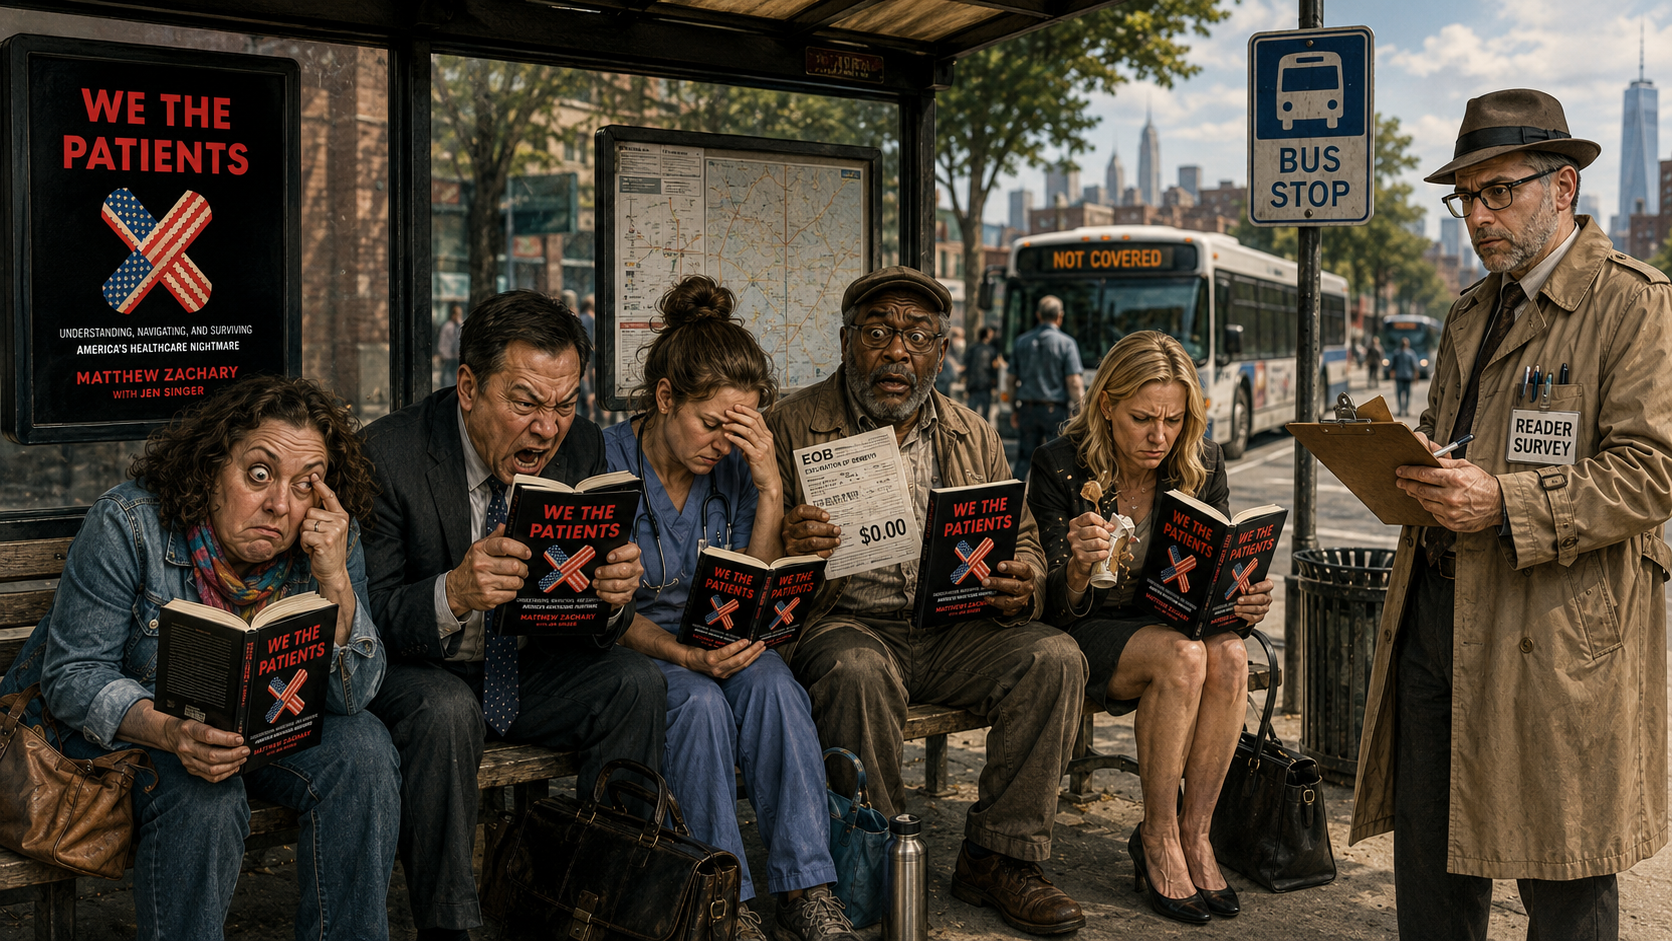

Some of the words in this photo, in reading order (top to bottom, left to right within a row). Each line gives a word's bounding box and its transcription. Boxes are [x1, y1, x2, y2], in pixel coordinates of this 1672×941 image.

[81, 88, 146, 125] WE
[160, 93, 231, 130] THE
[63, 135, 249, 175] PATIENTS
[1279, 145, 1341, 174] BUS
[1270, 180, 1351, 208] STOP
[1053, 250, 1086, 269] NOT
[1090, 249, 1162, 268] COVERED
[59, 326, 135, 339] UNDERSTANDING,
[137, 326, 189, 338] NAVIGATING,
[191, 326, 208, 336] AND
[210, 325, 253, 335] SURVIVING
[76, 343, 128, 355] AMERICA'S
[130, 342, 188, 354] HEALTHCARE
[190, 340, 240, 352] NIGHTMARE
[76, 368, 160, 385] MATTHEW
[163, 366, 238, 381] ZACHARY
[112, 389, 138, 399] WITH
[140, 388, 161, 398] JEN
[163, 386, 204, 397] SINGER
[1515, 418, 1573, 437] READER
[801, 448, 834, 465] EOB
[1513, 437, 1572, 457] SURVEY
[543, 504, 575, 521] WE
[580, 504, 616, 520] THE
[953, 501, 977, 518] WE
[981, 497, 1008, 514] THE
[529, 523, 621, 540] PATIENTS
[860, 518, 907, 546] $0.00
[944, 514, 1013, 537] PATIENTS
[1172, 509, 1191, 529] WE
[1193, 520, 1214, 541] THE
[1238, 530, 1254, 545] WE
[1255, 524, 1275, 540] THE
[1163, 522, 1214, 558] PATIENTS
[1229, 538, 1275, 561] PATIENTS
[714, 566, 732, 579] WE
[733, 571, 754, 586] THE
[779, 574, 793, 586] WE
[795, 571, 815, 583] THE
[705, 578, 755, 599] PATIENTS
[771, 582, 815, 599] PATIENTS
[267, 636, 289, 654] WE
[294, 624, 321, 645] THE
[258, 642, 325, 676] PATIENTS
